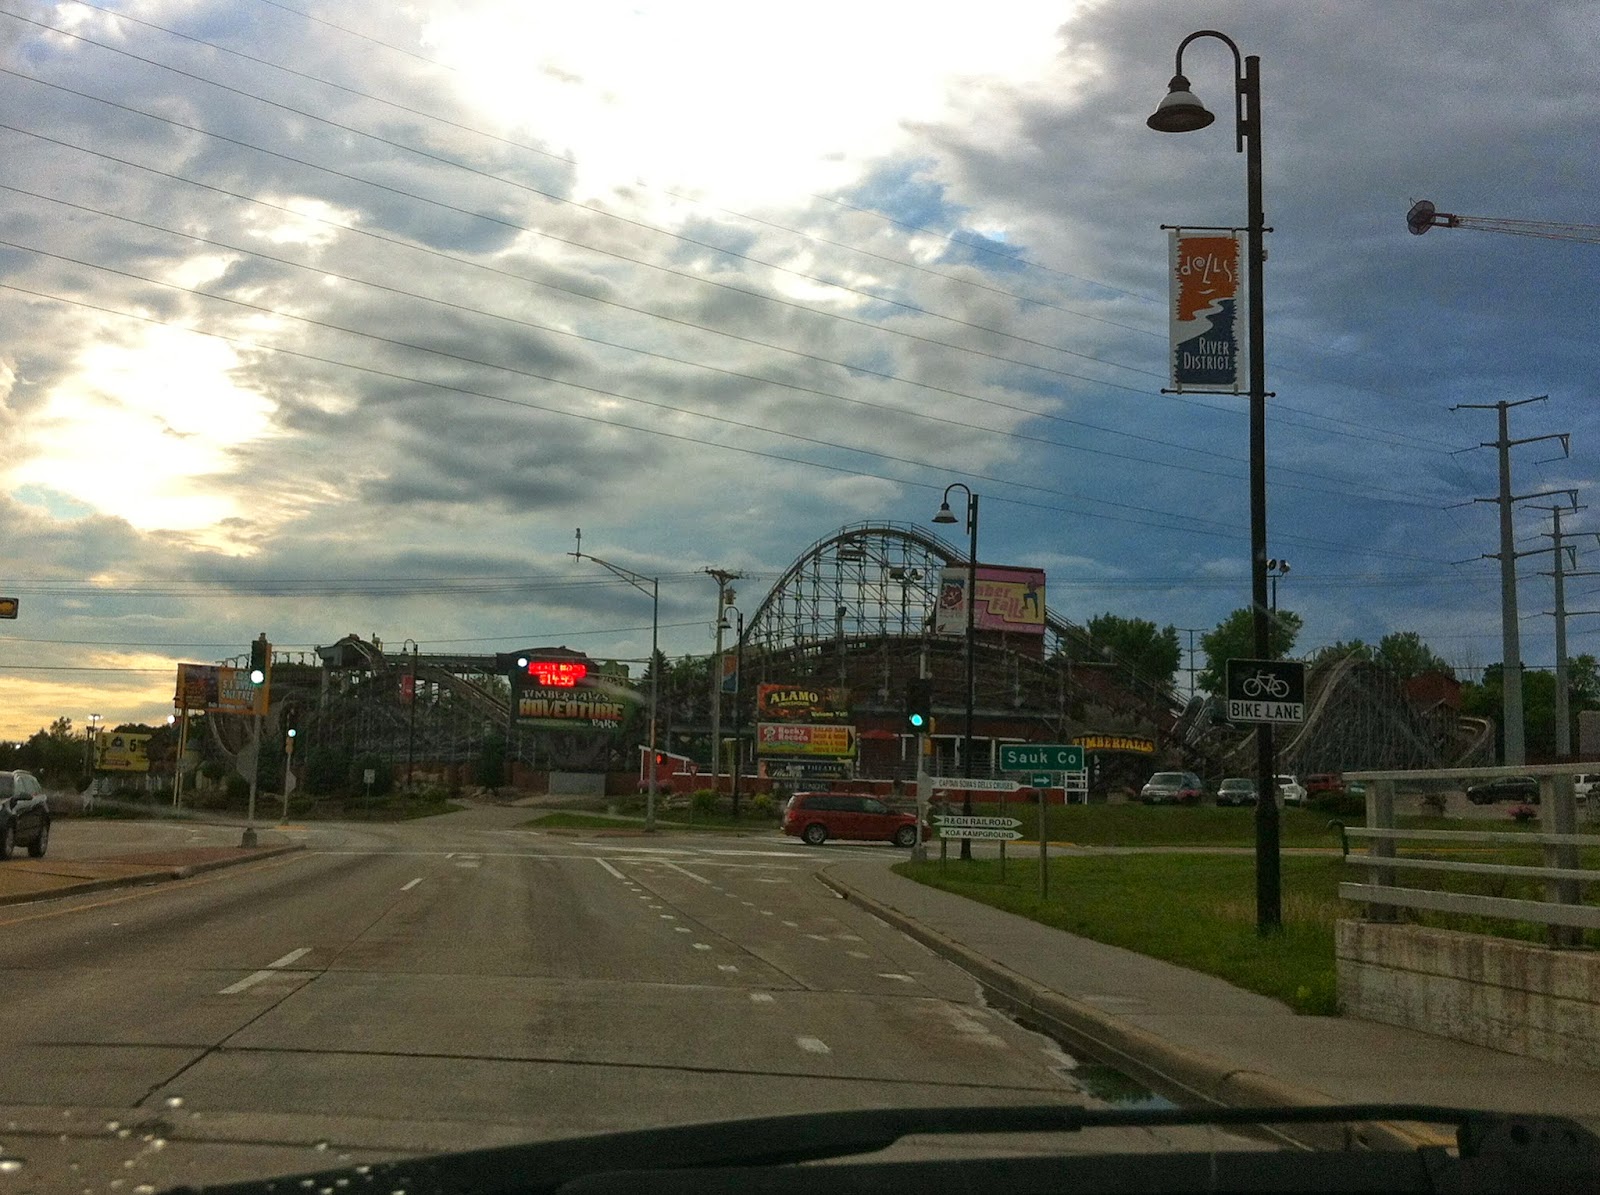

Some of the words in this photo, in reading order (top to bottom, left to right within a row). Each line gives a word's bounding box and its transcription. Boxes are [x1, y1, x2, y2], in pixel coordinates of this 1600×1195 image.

[1199, 337, 1229, 355] RIVER
[770, 690, 819, 704] ALAMO
[1231, 702, 1261, 717] BIKE
[1265, 704, 1300, 719] LANE
[592, 719, 618, 729] PARK
[778, 727, 805, 735] Rocky
[1008, 751, 1048, 764] Sauk
[1057, 752, 1076, 764] Co
[970, 818, 1013, 827] RAILROAD
[962, 830, 1014, 839] KAMPGROUND
